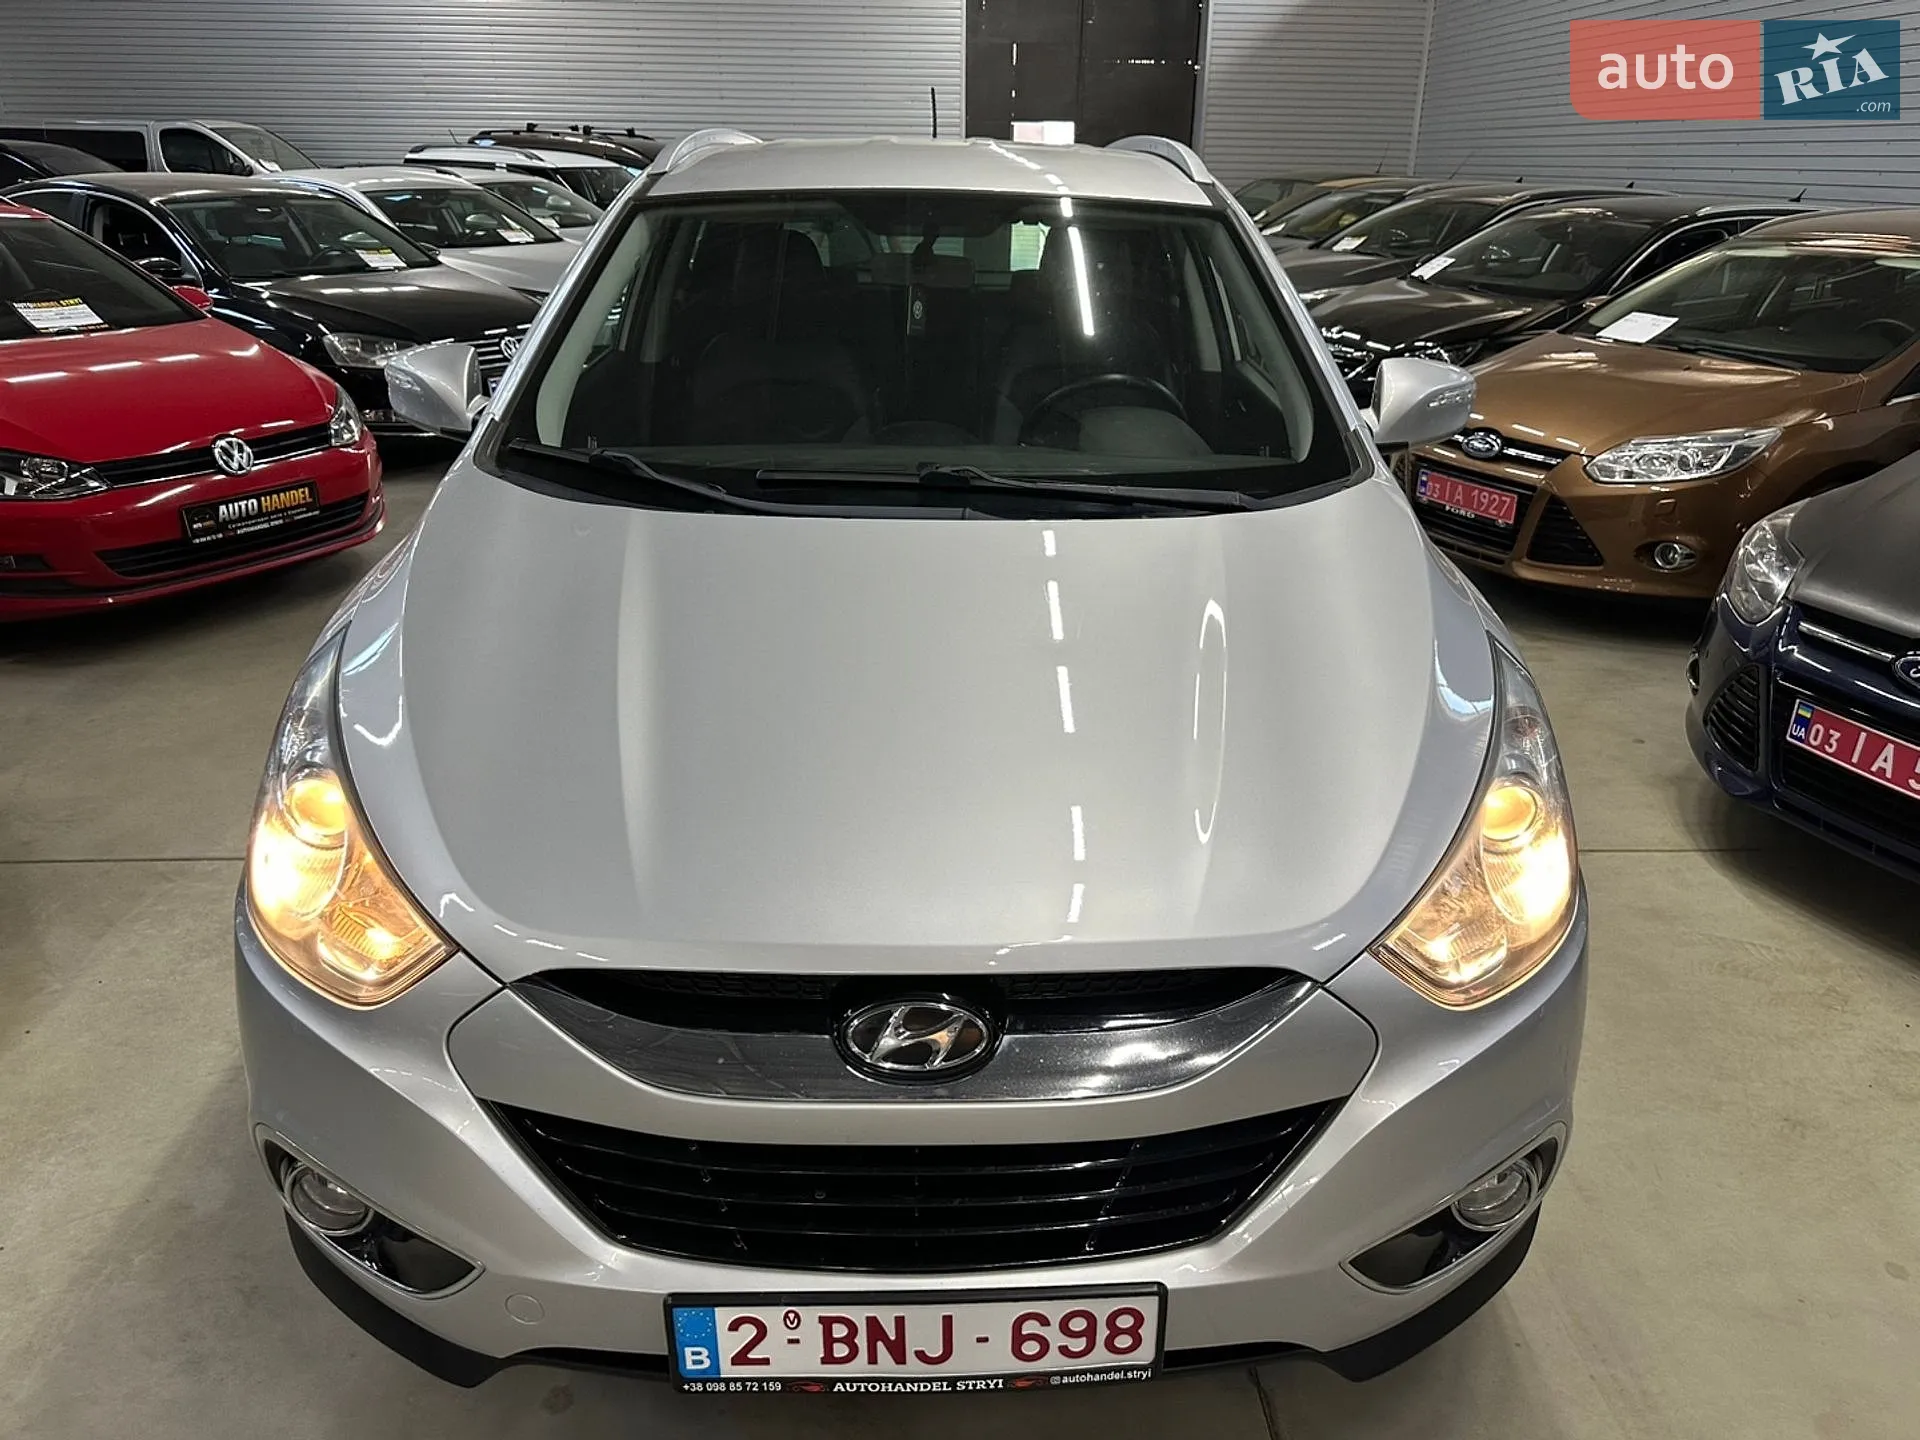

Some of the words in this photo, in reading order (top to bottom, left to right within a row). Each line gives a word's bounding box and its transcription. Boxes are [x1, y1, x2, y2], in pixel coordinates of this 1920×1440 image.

[218, 498, 258, 522] AUTO
[261, 486, 312, 513] HANDEL
[1426, 482, 1440, 499] 03
[1471, 488, 1512, 517] 1927
[1791, 723, 1807, 741] UA
[1808, 723, 1841, 754] 03
[1851, 731, 1896, 780] IA
[684, 1346, 711, 1371] B
[682, 1382, 703, 1393] +38
[706, 1382, 727, 1392] 098
[729, 1382, 743, 1392] 85
[745, 1382, 759, 1392] 72
[762, 1381, 782, 1392] 159
[833, 1380, 952, 1393] AUTOHANDEL
[956, 1378, 1004, 1391] STRYI
